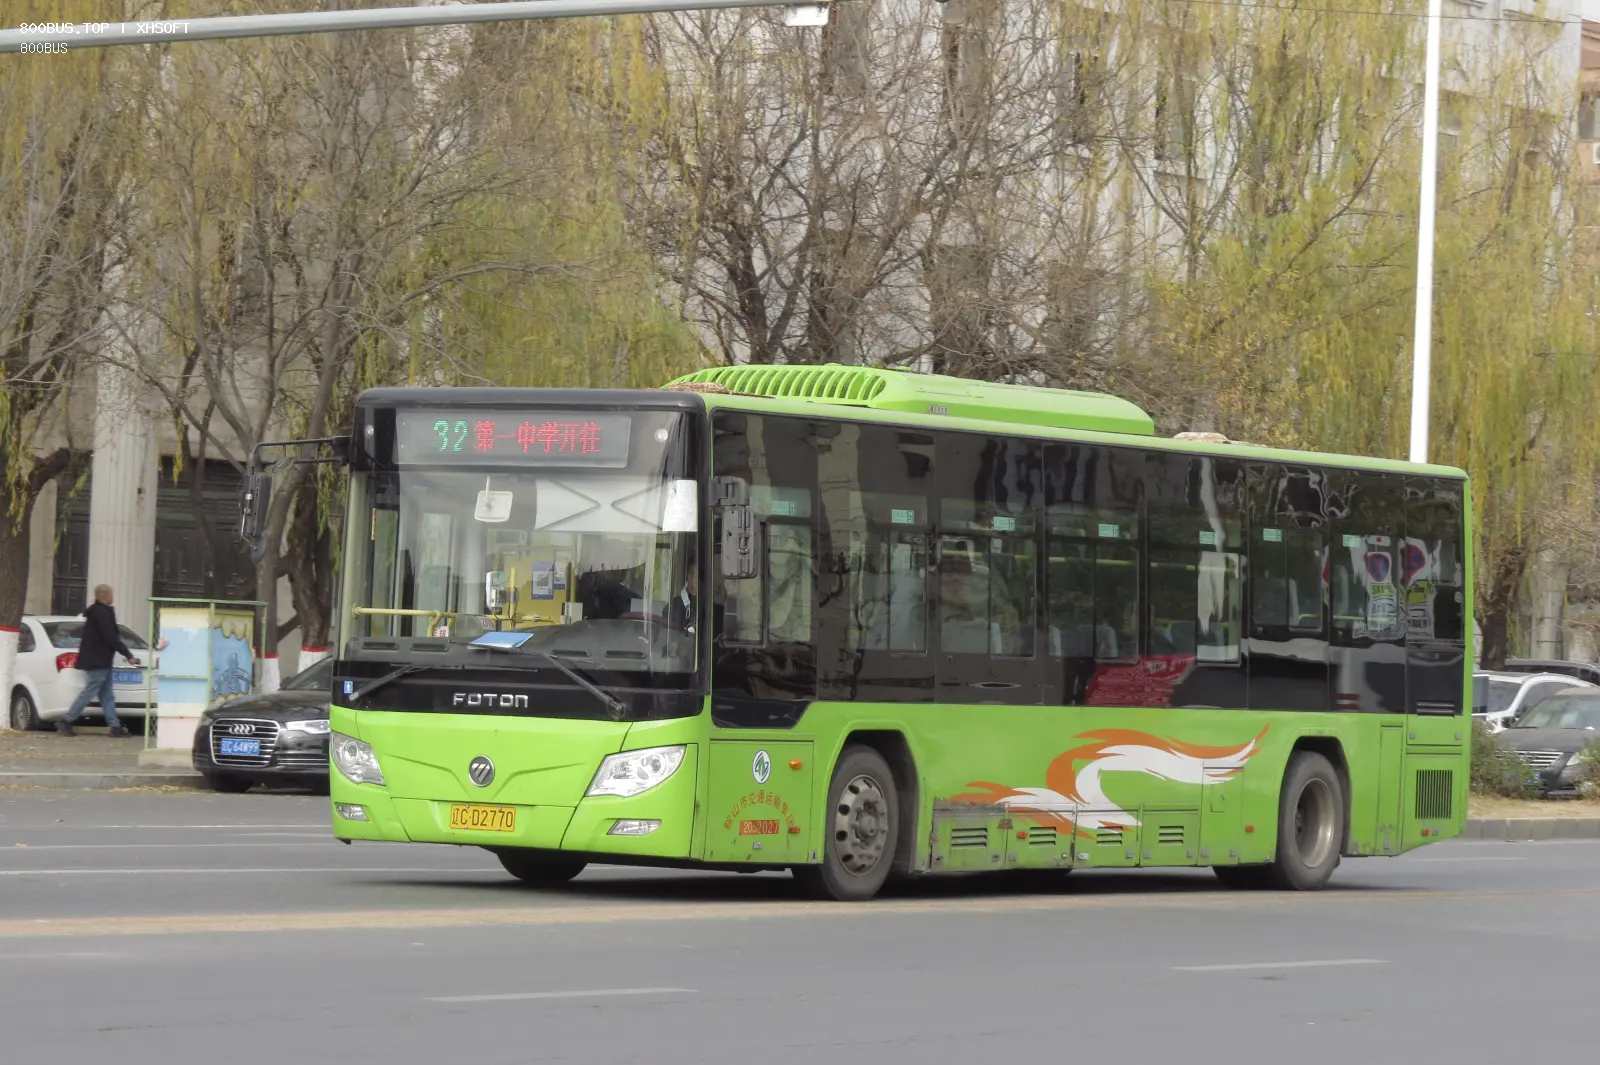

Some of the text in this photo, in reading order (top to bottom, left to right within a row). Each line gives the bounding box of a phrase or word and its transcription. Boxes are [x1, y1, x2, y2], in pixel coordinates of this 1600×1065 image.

[433, 420, 602, 453] 32 第一中学开往
[452, 692, 529, 708] FOTON
